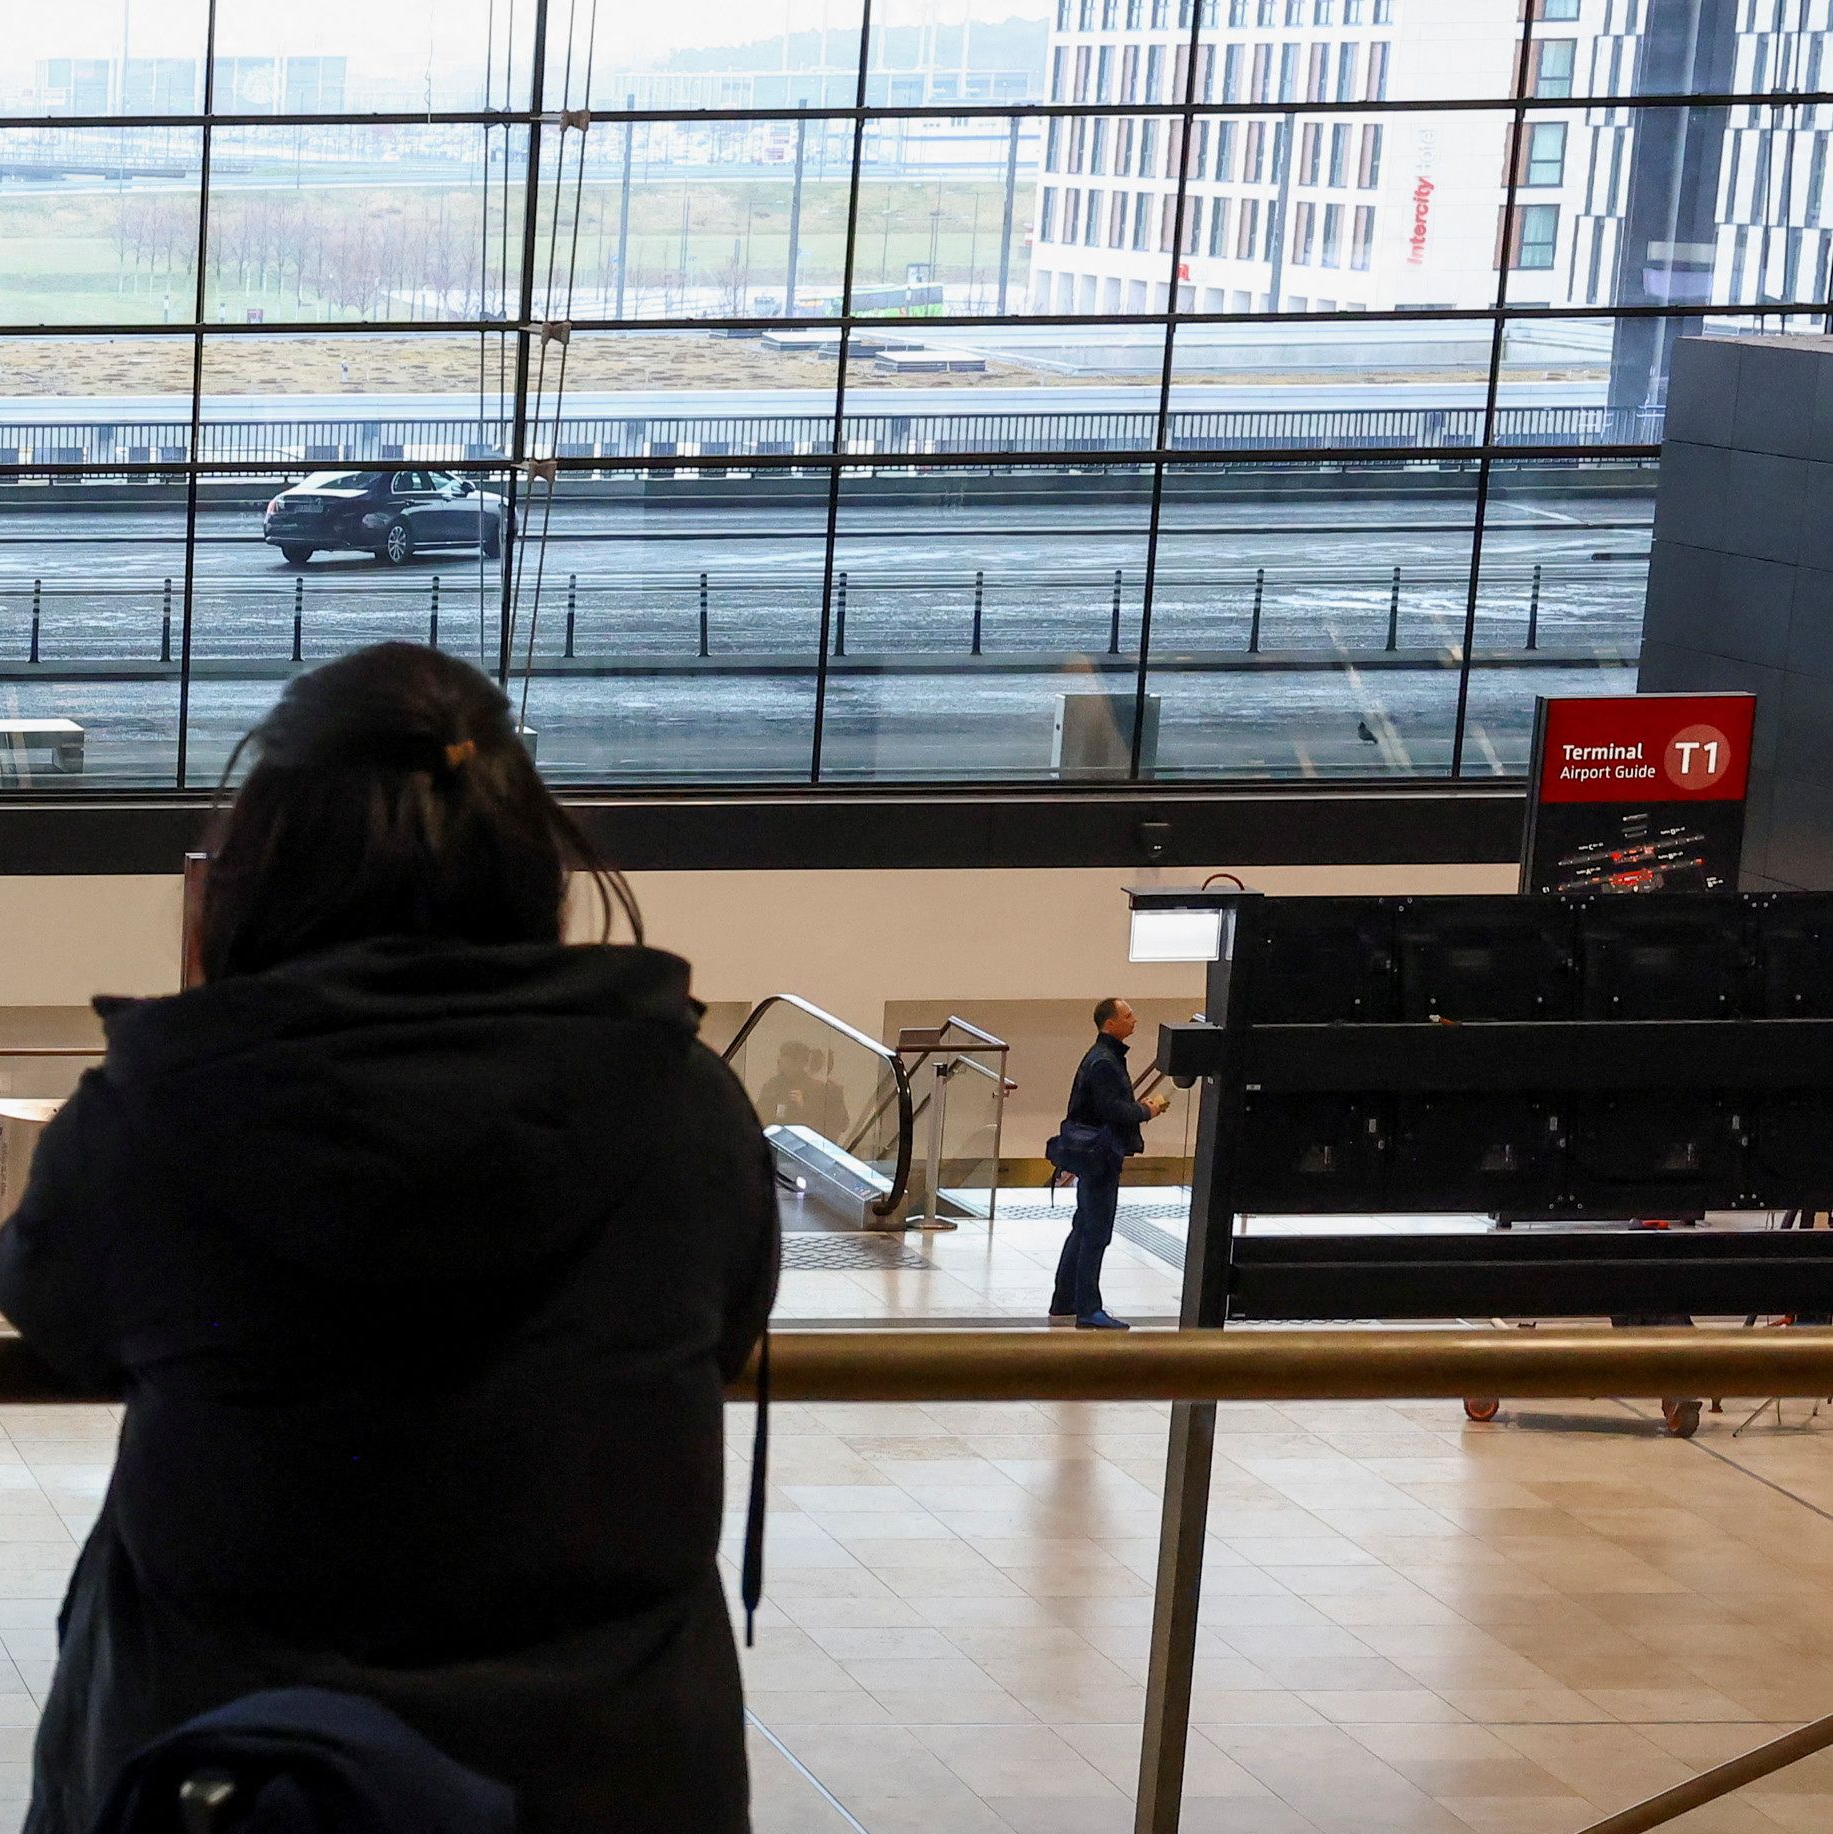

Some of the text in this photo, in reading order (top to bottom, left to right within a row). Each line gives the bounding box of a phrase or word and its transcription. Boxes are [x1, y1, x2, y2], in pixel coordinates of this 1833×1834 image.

[1563, 742, 1643, 760] Terminal
[1674, 741, 1718, 774] T1
[1560, 765, 1656, 782] Airport Guide
